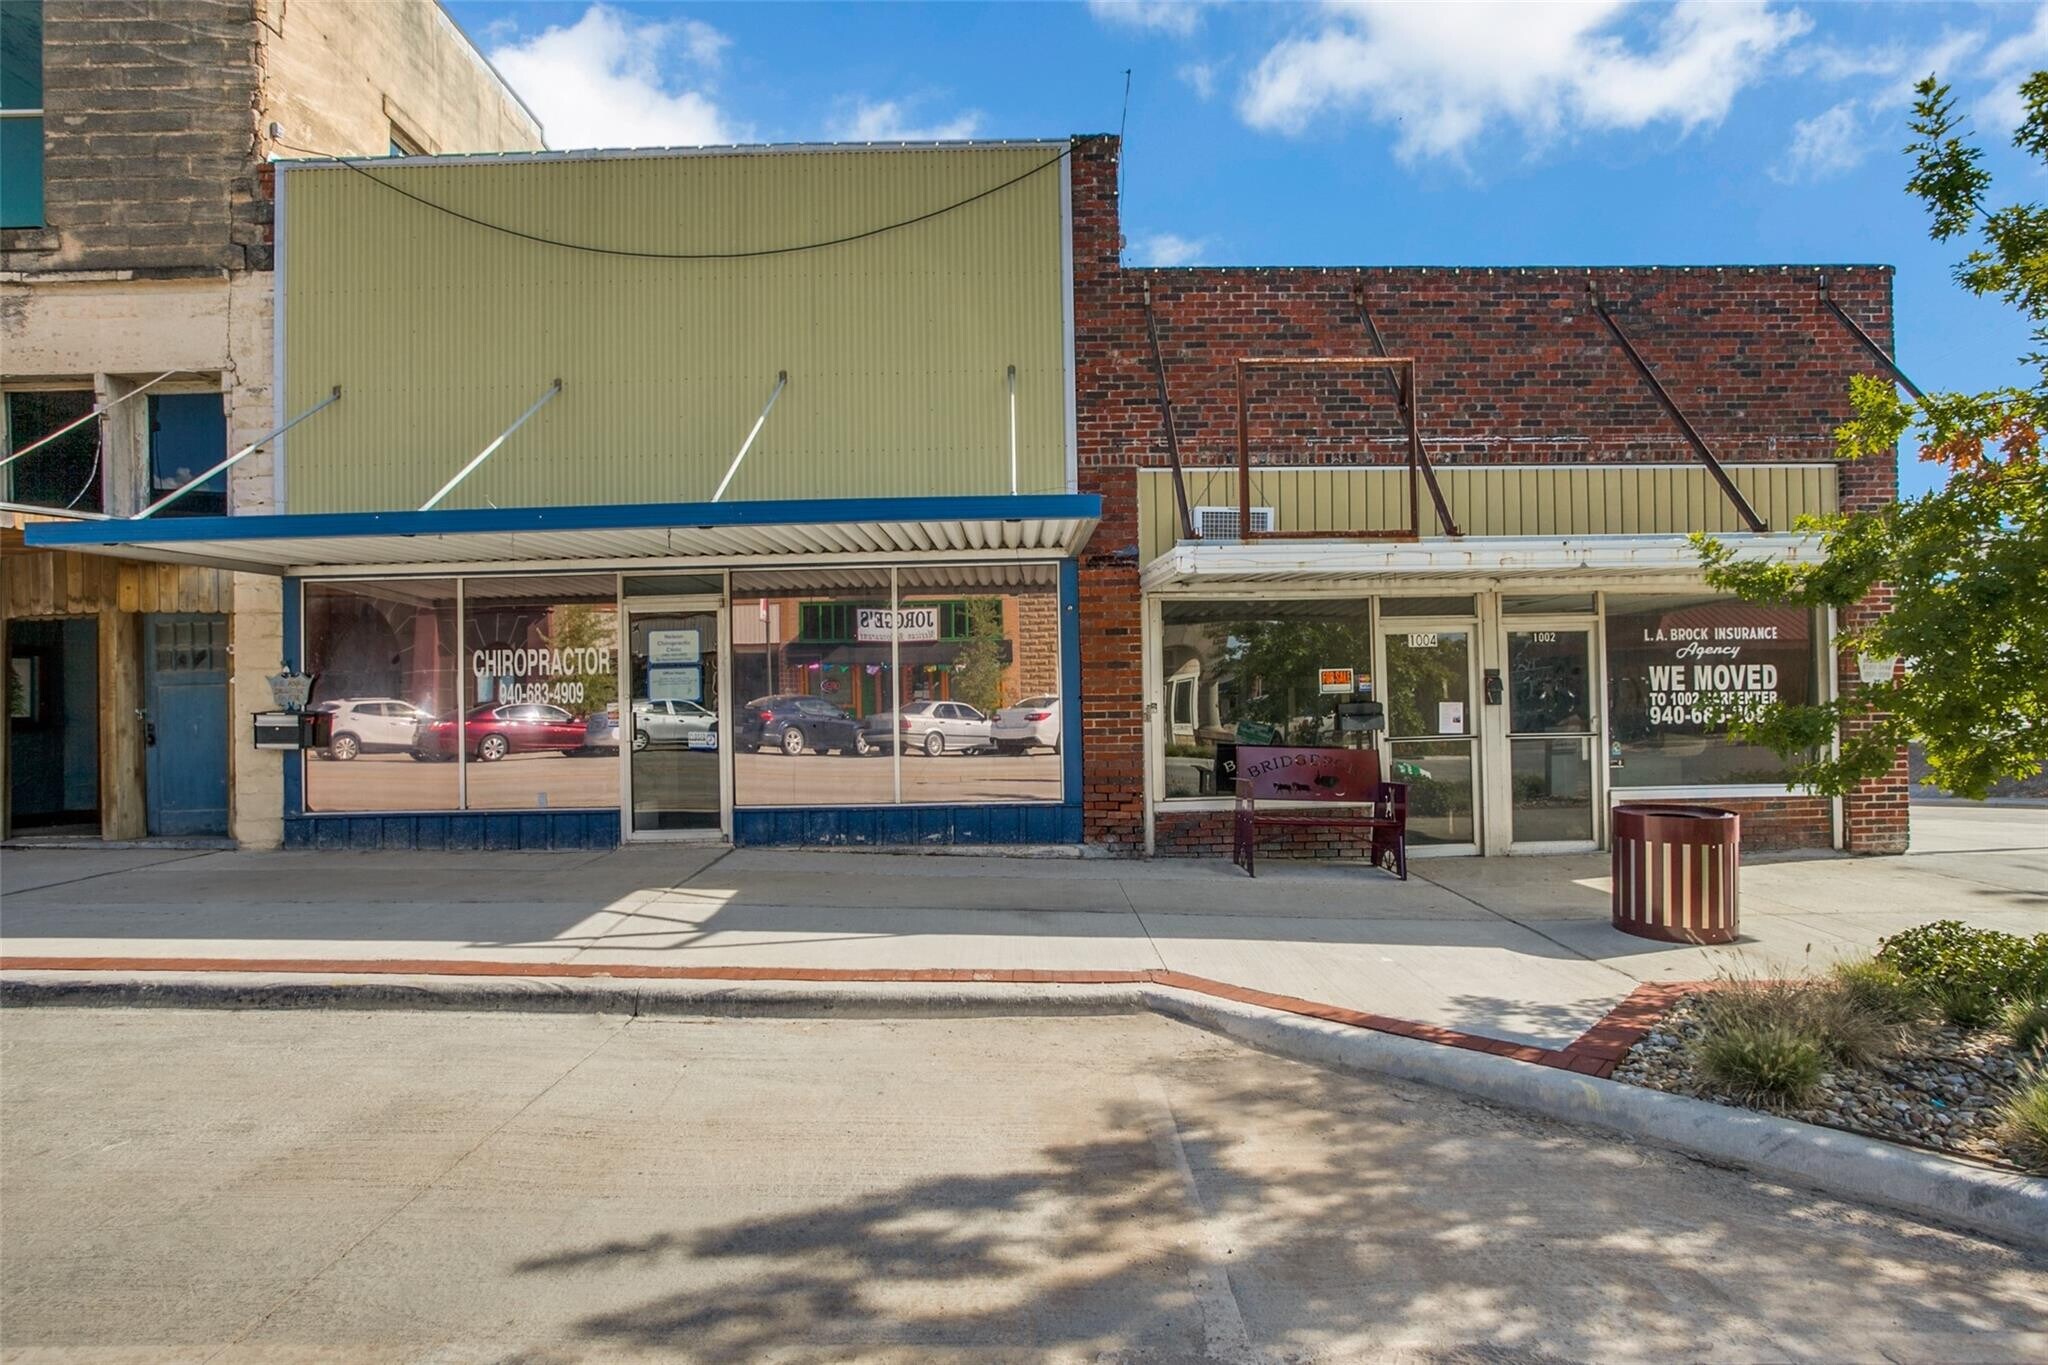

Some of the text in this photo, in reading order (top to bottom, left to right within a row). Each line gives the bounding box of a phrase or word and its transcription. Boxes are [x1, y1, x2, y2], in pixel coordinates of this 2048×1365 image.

[1533, 632, 1556, 643] 1002
[1670, 627, 1708, 640] BROCK
[1714, 626, 1778, 640] INSURANCE
[1409, 634, 1437, 647] 1004
[1676, 641, 1741, 660] Agency
[472, 646, 610, 678] CHIROPRACTOR
[1322, 671, 1351, 684] FOR SALE
[1649, 664, 1778, 692] WE MOVED
[500, 681, 584, 705] 940-683-4909
[1649, 692, 1667, 706] TO
[1670, 692, 1700, 706] 1002
